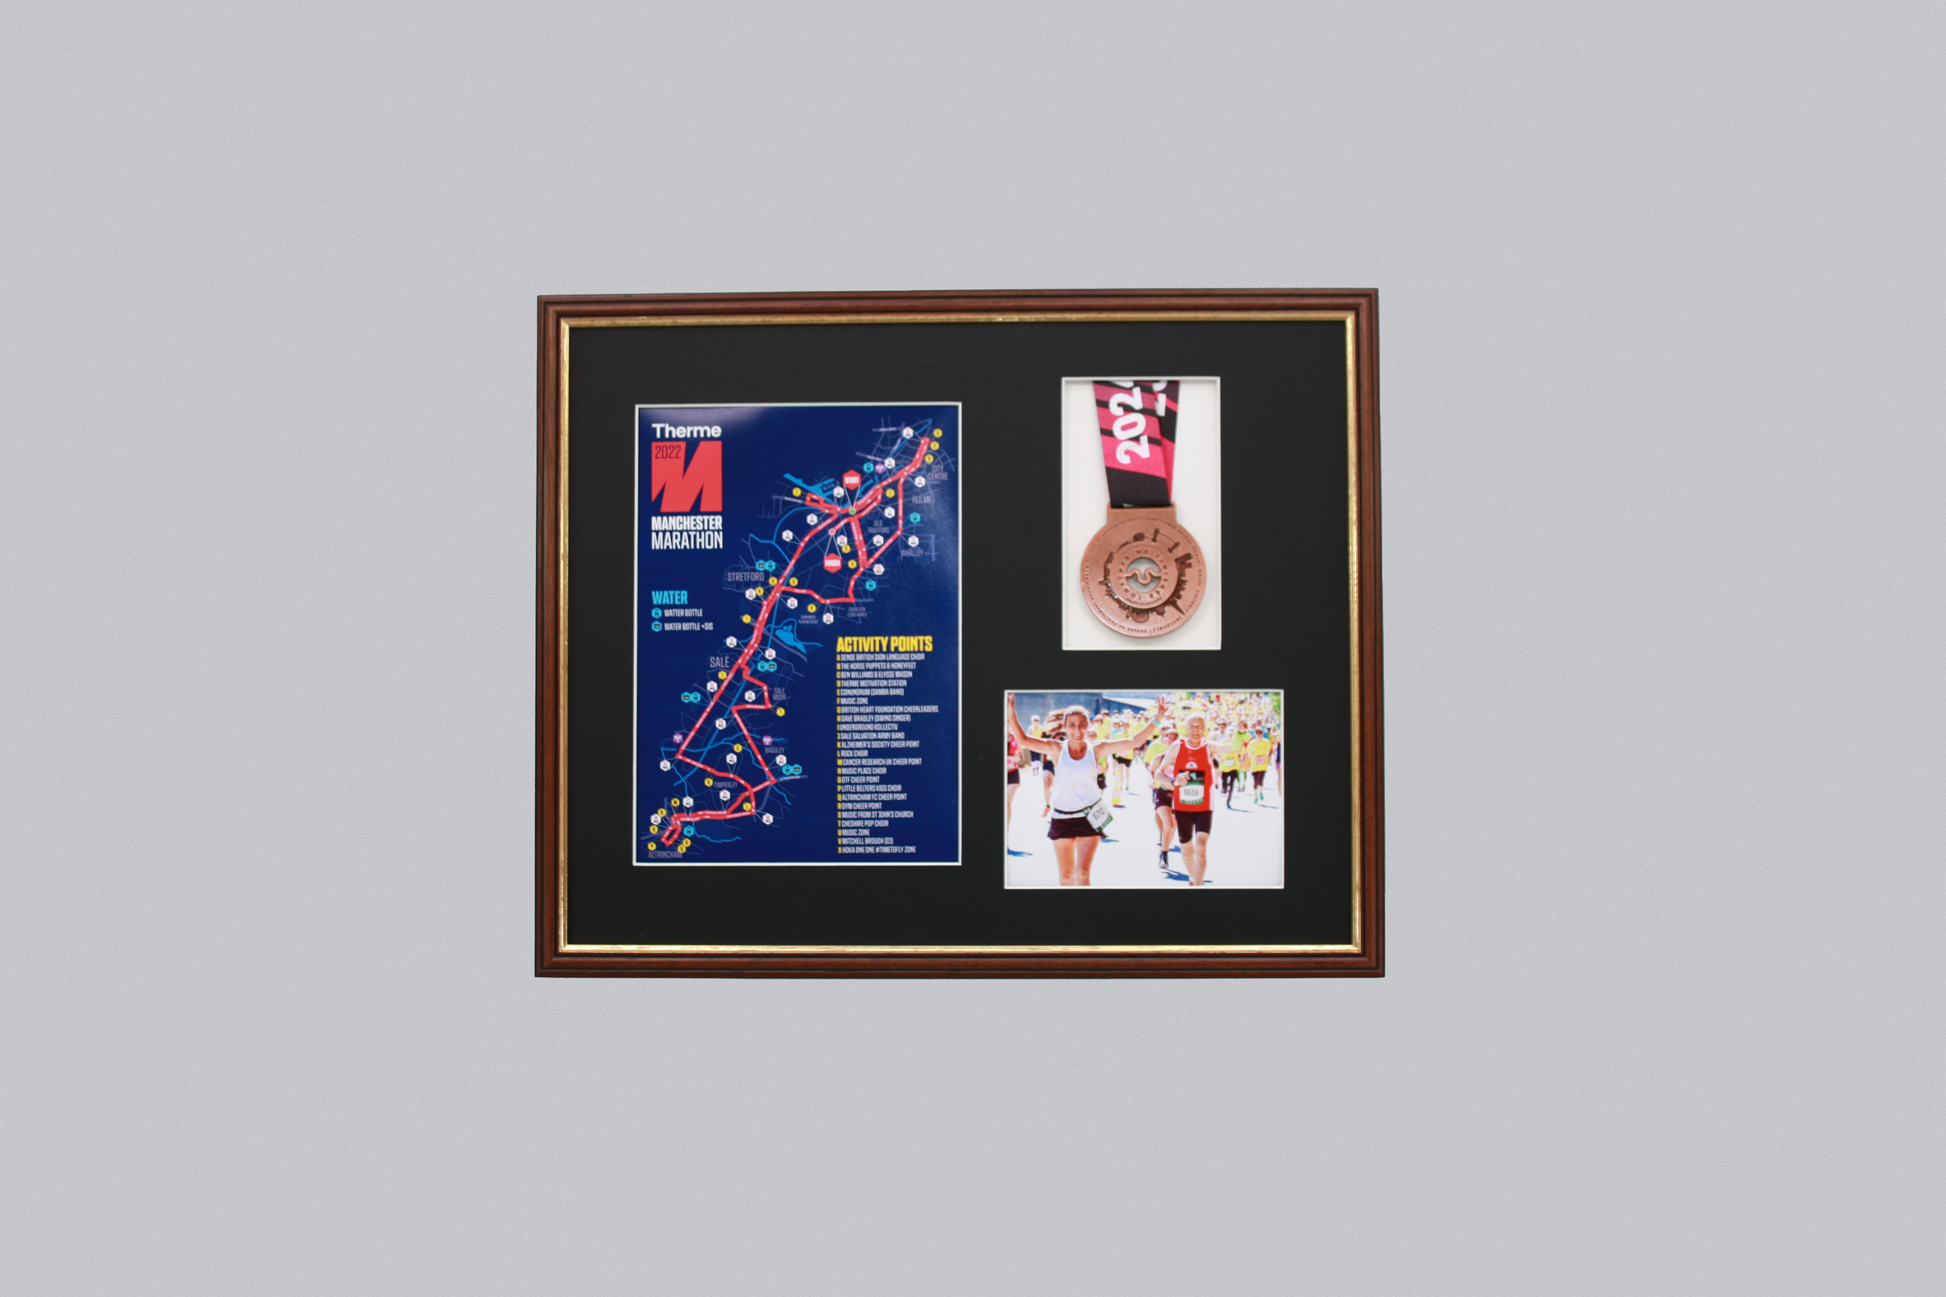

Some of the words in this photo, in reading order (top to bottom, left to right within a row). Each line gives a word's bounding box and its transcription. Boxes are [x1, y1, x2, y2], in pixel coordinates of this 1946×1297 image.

[1108, 380, 1150, 464] 202
[651, 423, 722, 438] Therme
[655, 445, 681, 459] 2022
[651, 515, 723, 531] MANCHESTER
[651, 531, 723, 550] MARATHON
[727, 572, 765, 582] STRETFORD
[651, 590, 688, 605] WATER
[664, 609, 684, 617] WATTER
[684, 608, 703, 617] BOTTLE
[664, 622, 682, 631] WATER
[682, 622, 701, 631] BOTTLE
[836, 636, 889, 653] ACTIVITY
[890, 635, 933, 652] POINTS
[709, 656, 730, 668] SALE
